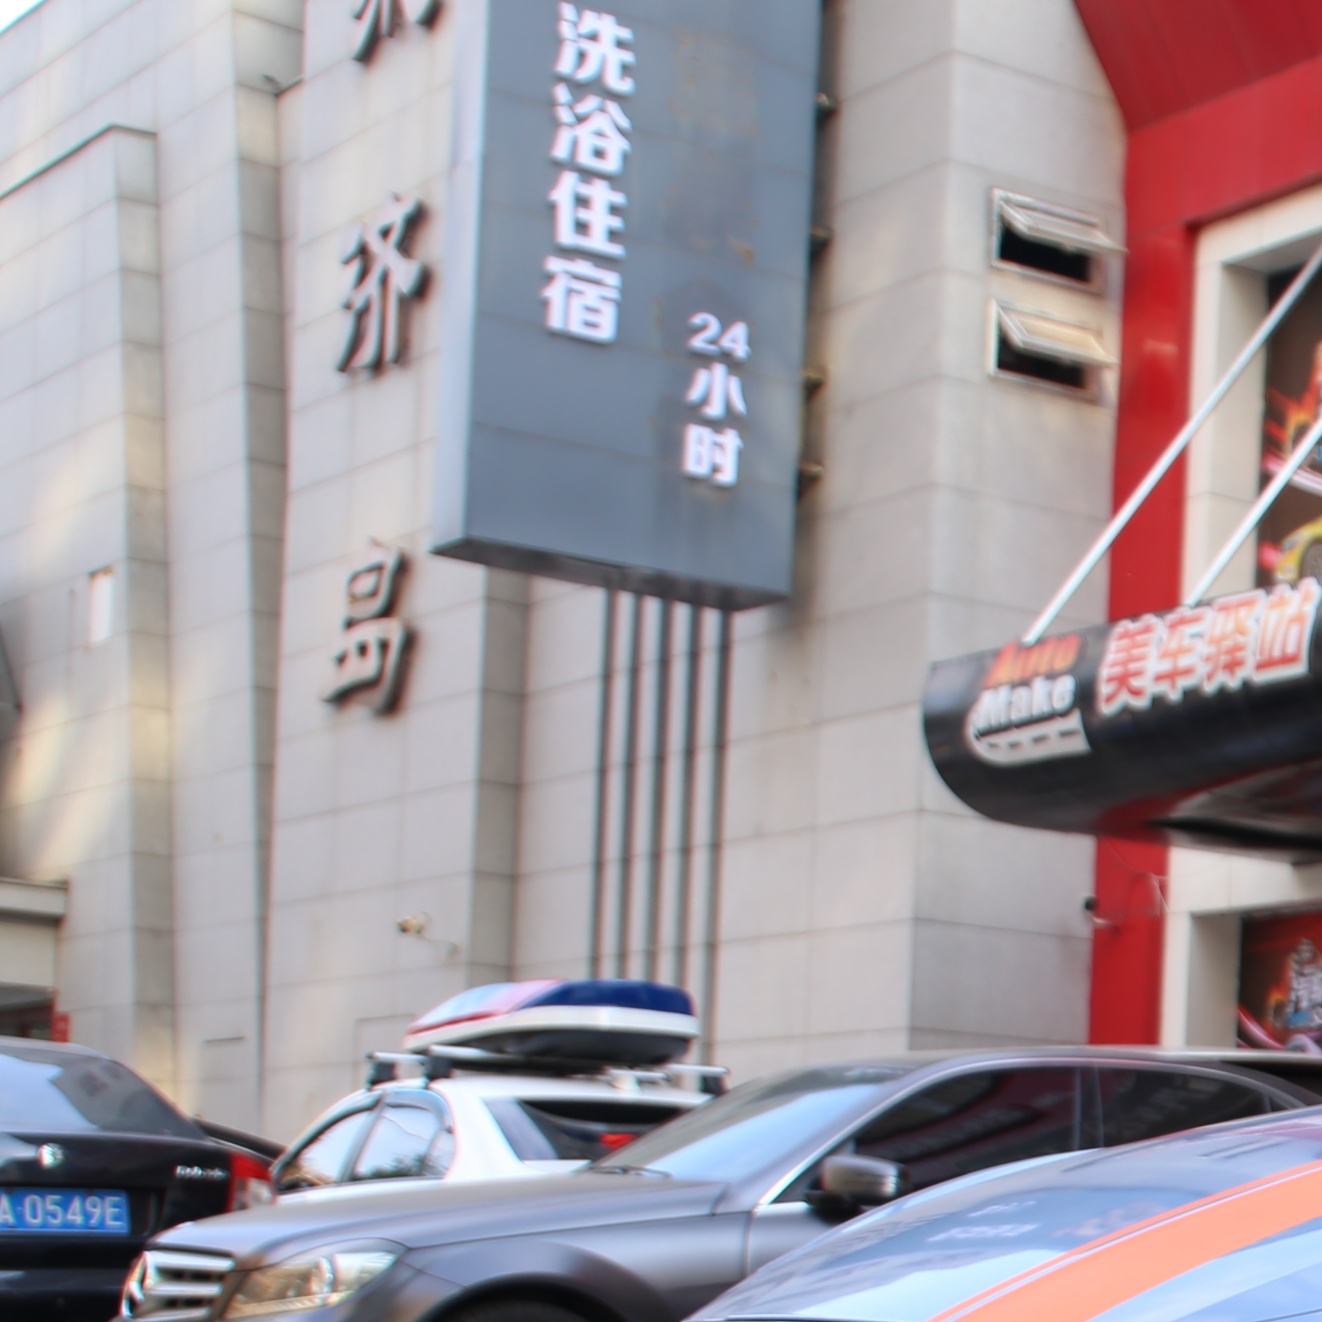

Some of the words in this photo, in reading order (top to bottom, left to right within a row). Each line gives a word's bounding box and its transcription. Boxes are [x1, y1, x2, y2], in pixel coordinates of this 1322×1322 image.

[541, 2, 636, 345] 洗浴住宿
[972, 674, 1077, 734] Make
